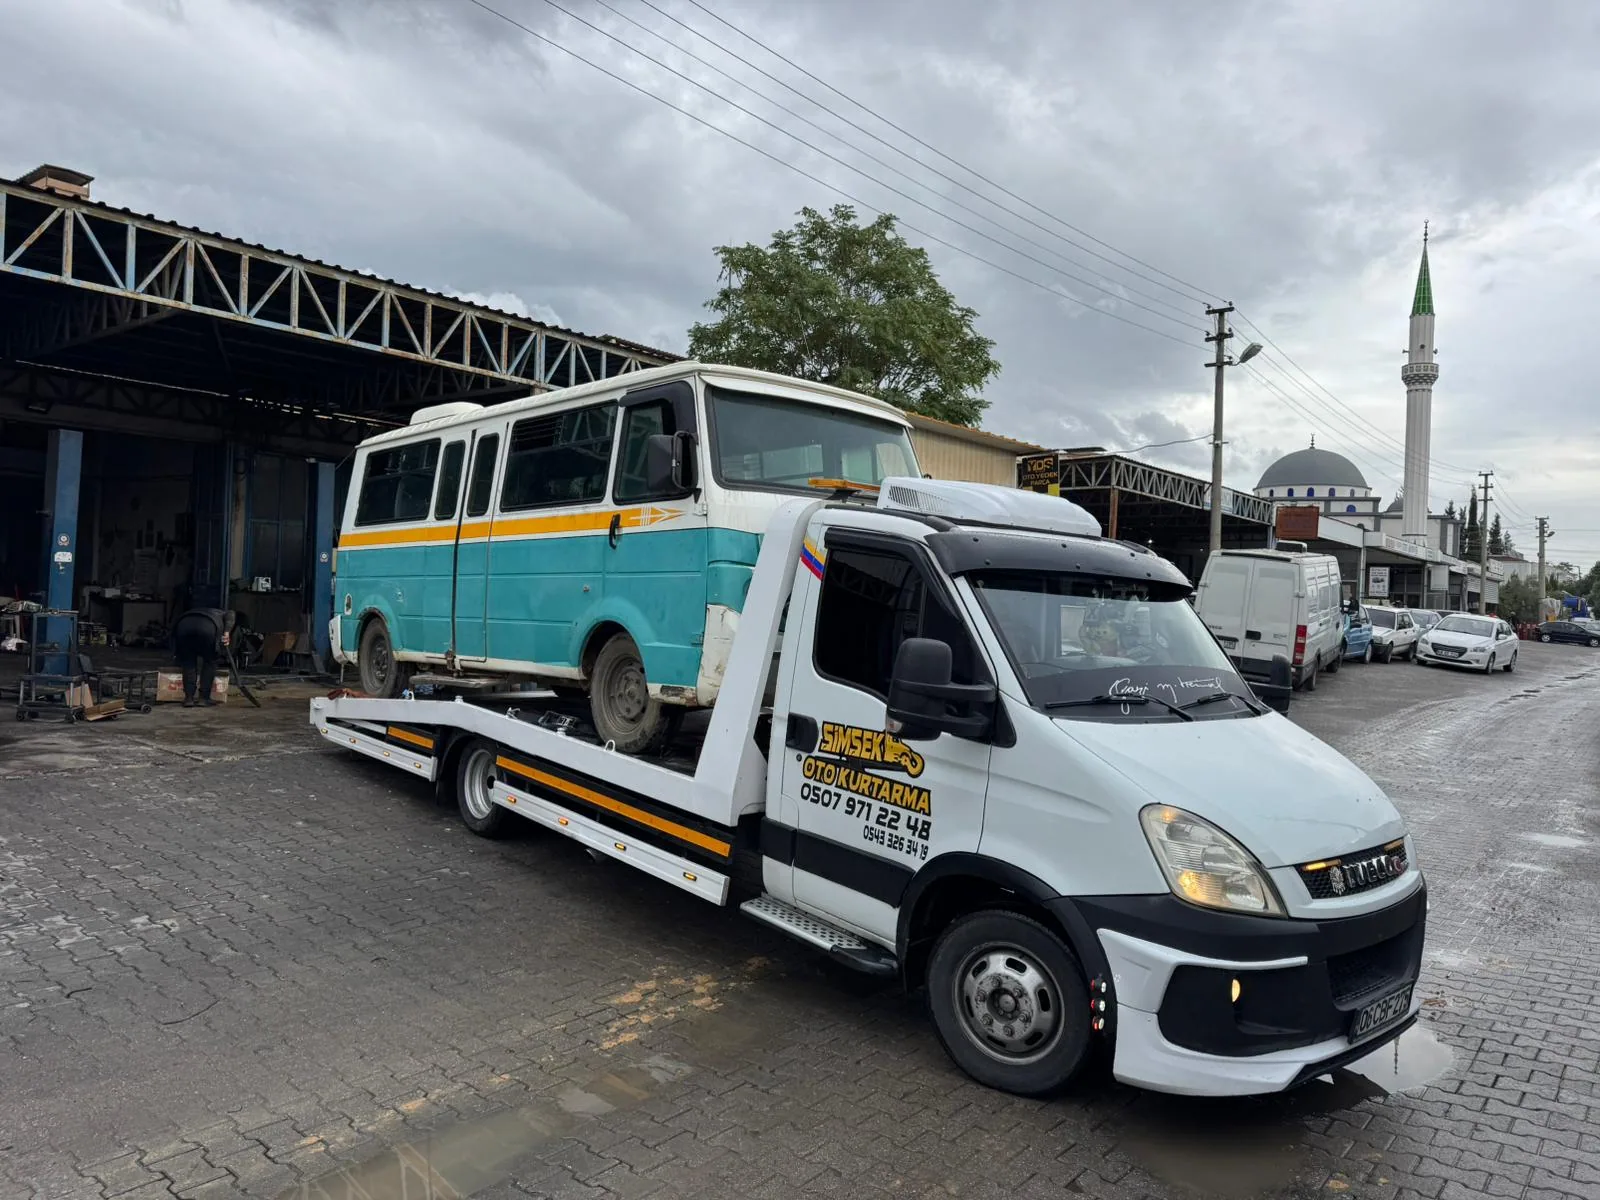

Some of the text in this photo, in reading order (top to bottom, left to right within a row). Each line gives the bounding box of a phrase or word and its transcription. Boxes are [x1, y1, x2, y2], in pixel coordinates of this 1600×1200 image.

[801, 783, 931, 841] 0507 971 22 48
[803, 756, 931, 816] OTO KURTARMA
[863, 825, 929, 860] 0543 326 34 19
